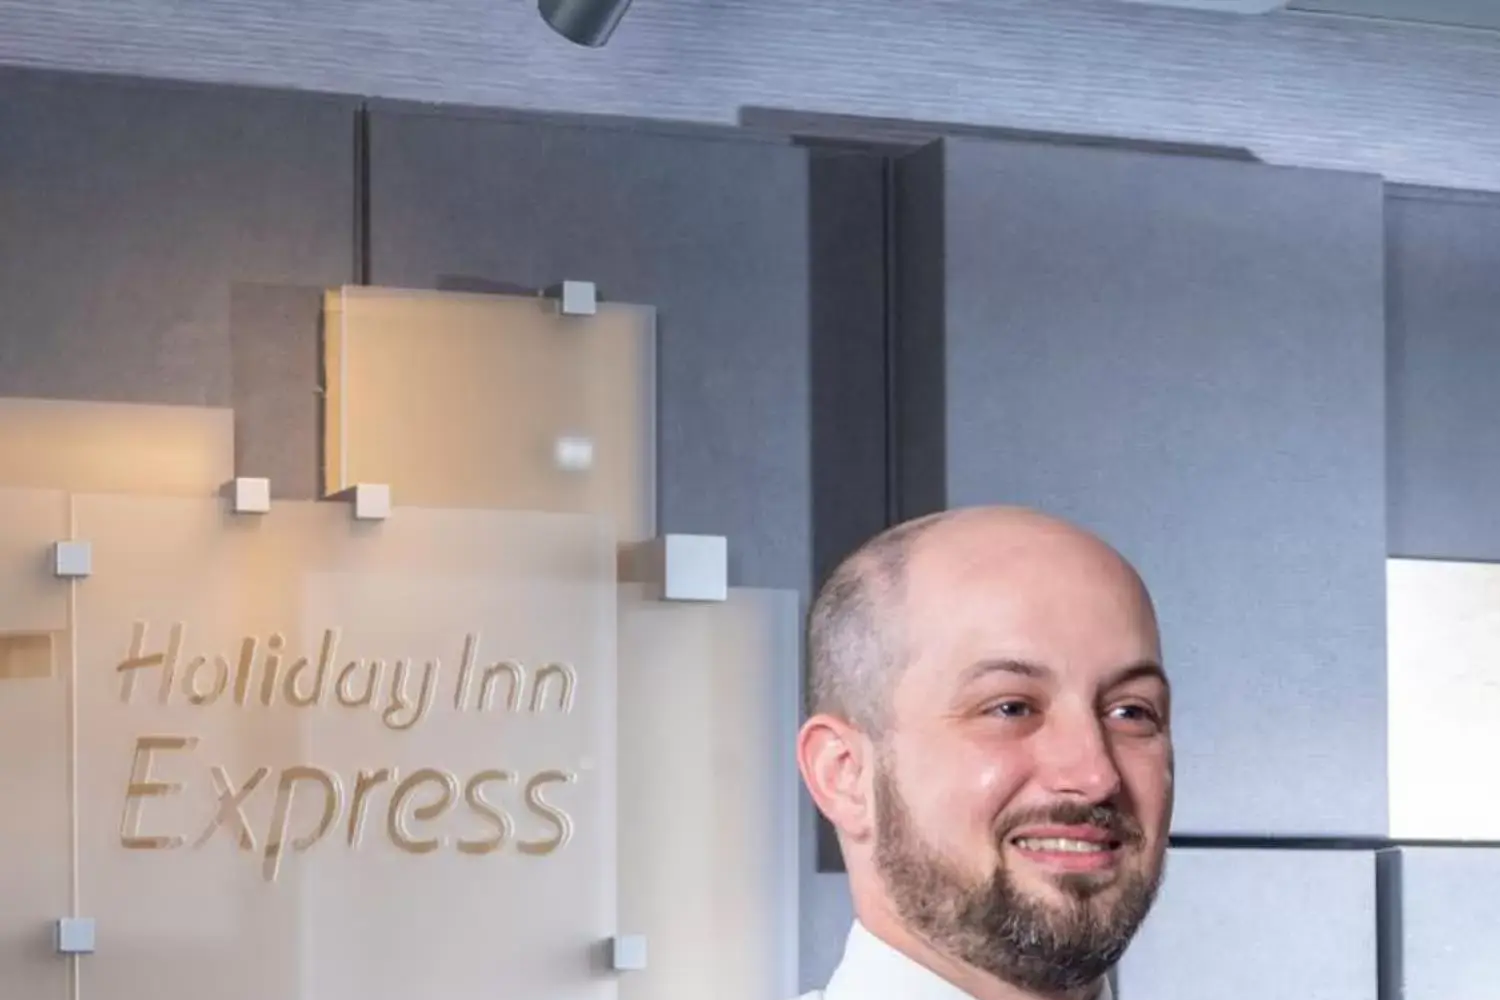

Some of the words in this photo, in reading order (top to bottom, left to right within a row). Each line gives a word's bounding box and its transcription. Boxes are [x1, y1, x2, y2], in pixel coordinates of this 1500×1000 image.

[117, 619, 441, 730] Holiday
[453, 630, 578, 715] Inn
[118, 735, 578, 882] Express
